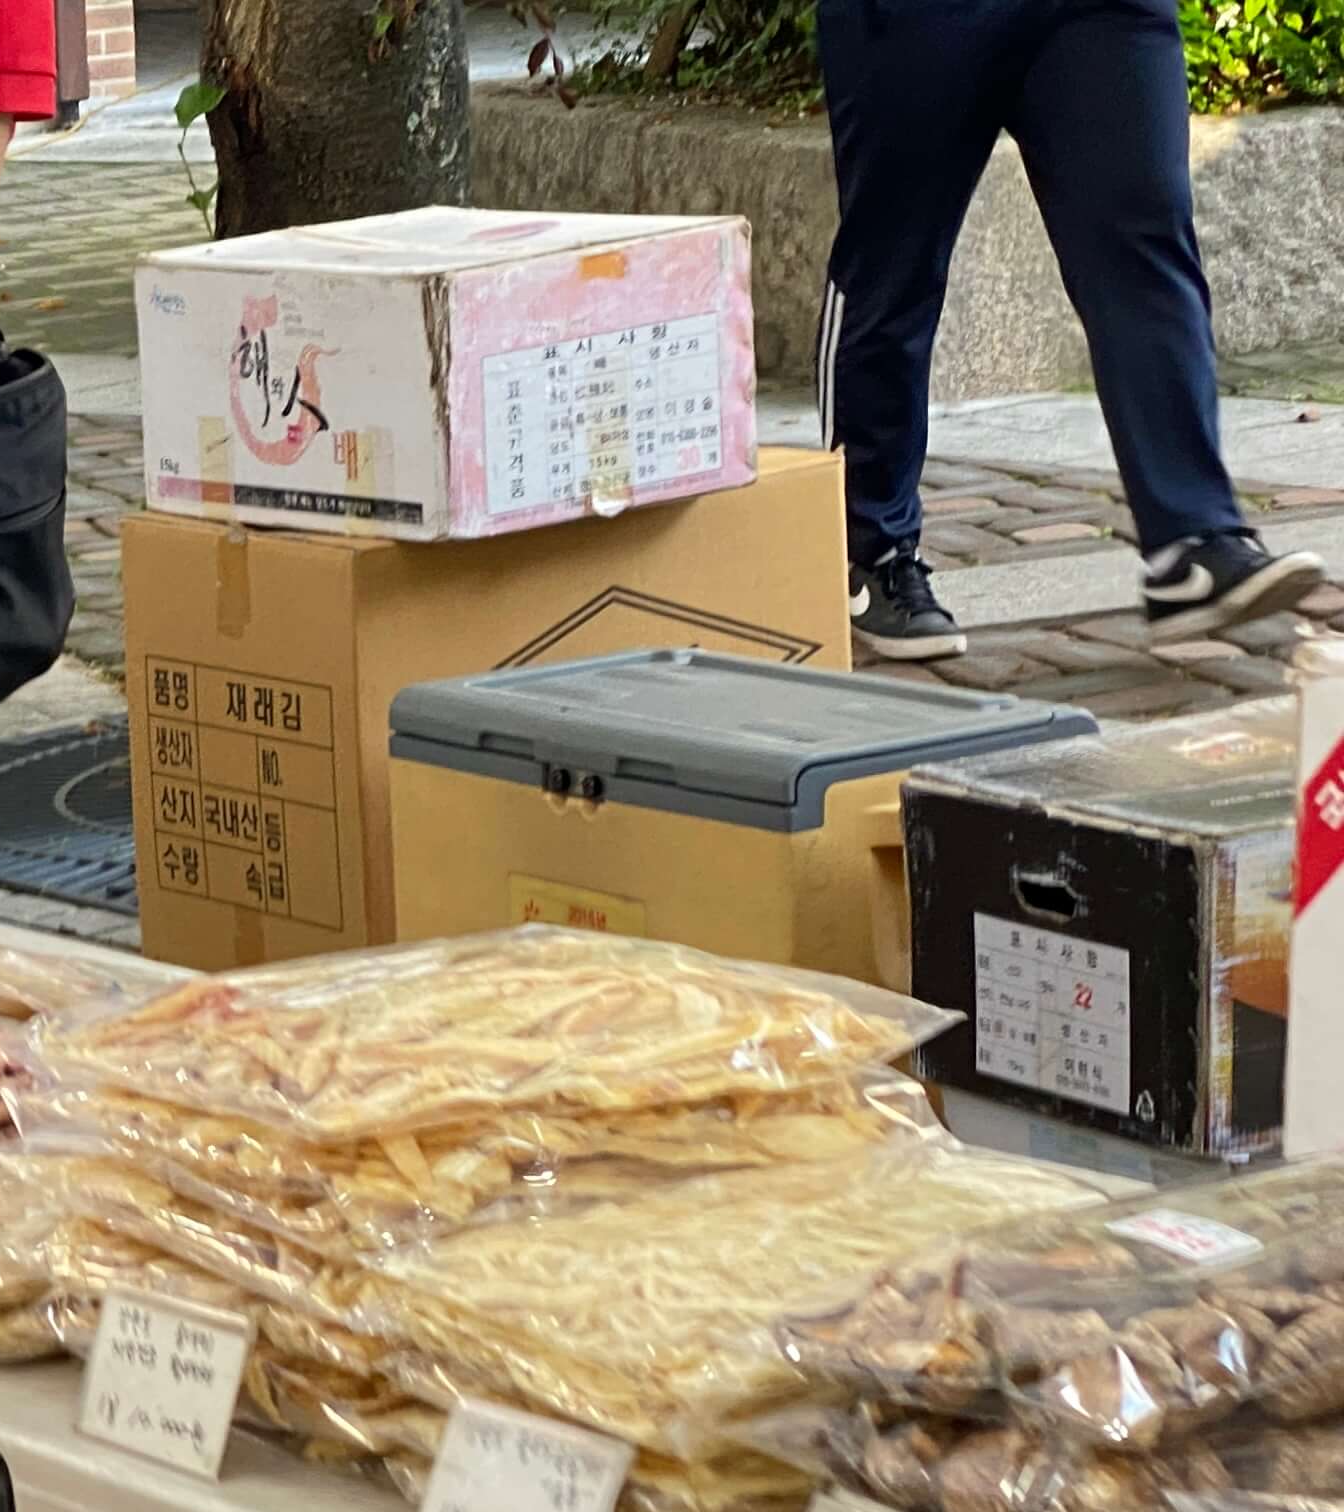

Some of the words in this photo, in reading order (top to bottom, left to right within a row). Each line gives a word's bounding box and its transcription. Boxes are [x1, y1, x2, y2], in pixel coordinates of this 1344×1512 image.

[154, 668, 189, 711] 품명
[226, 681, 301, 732] 재래김
[160, 785, 196, 829] 산지
[204, 795, 258, 842] 국내산
[163, 843, 199, 885] 수량
